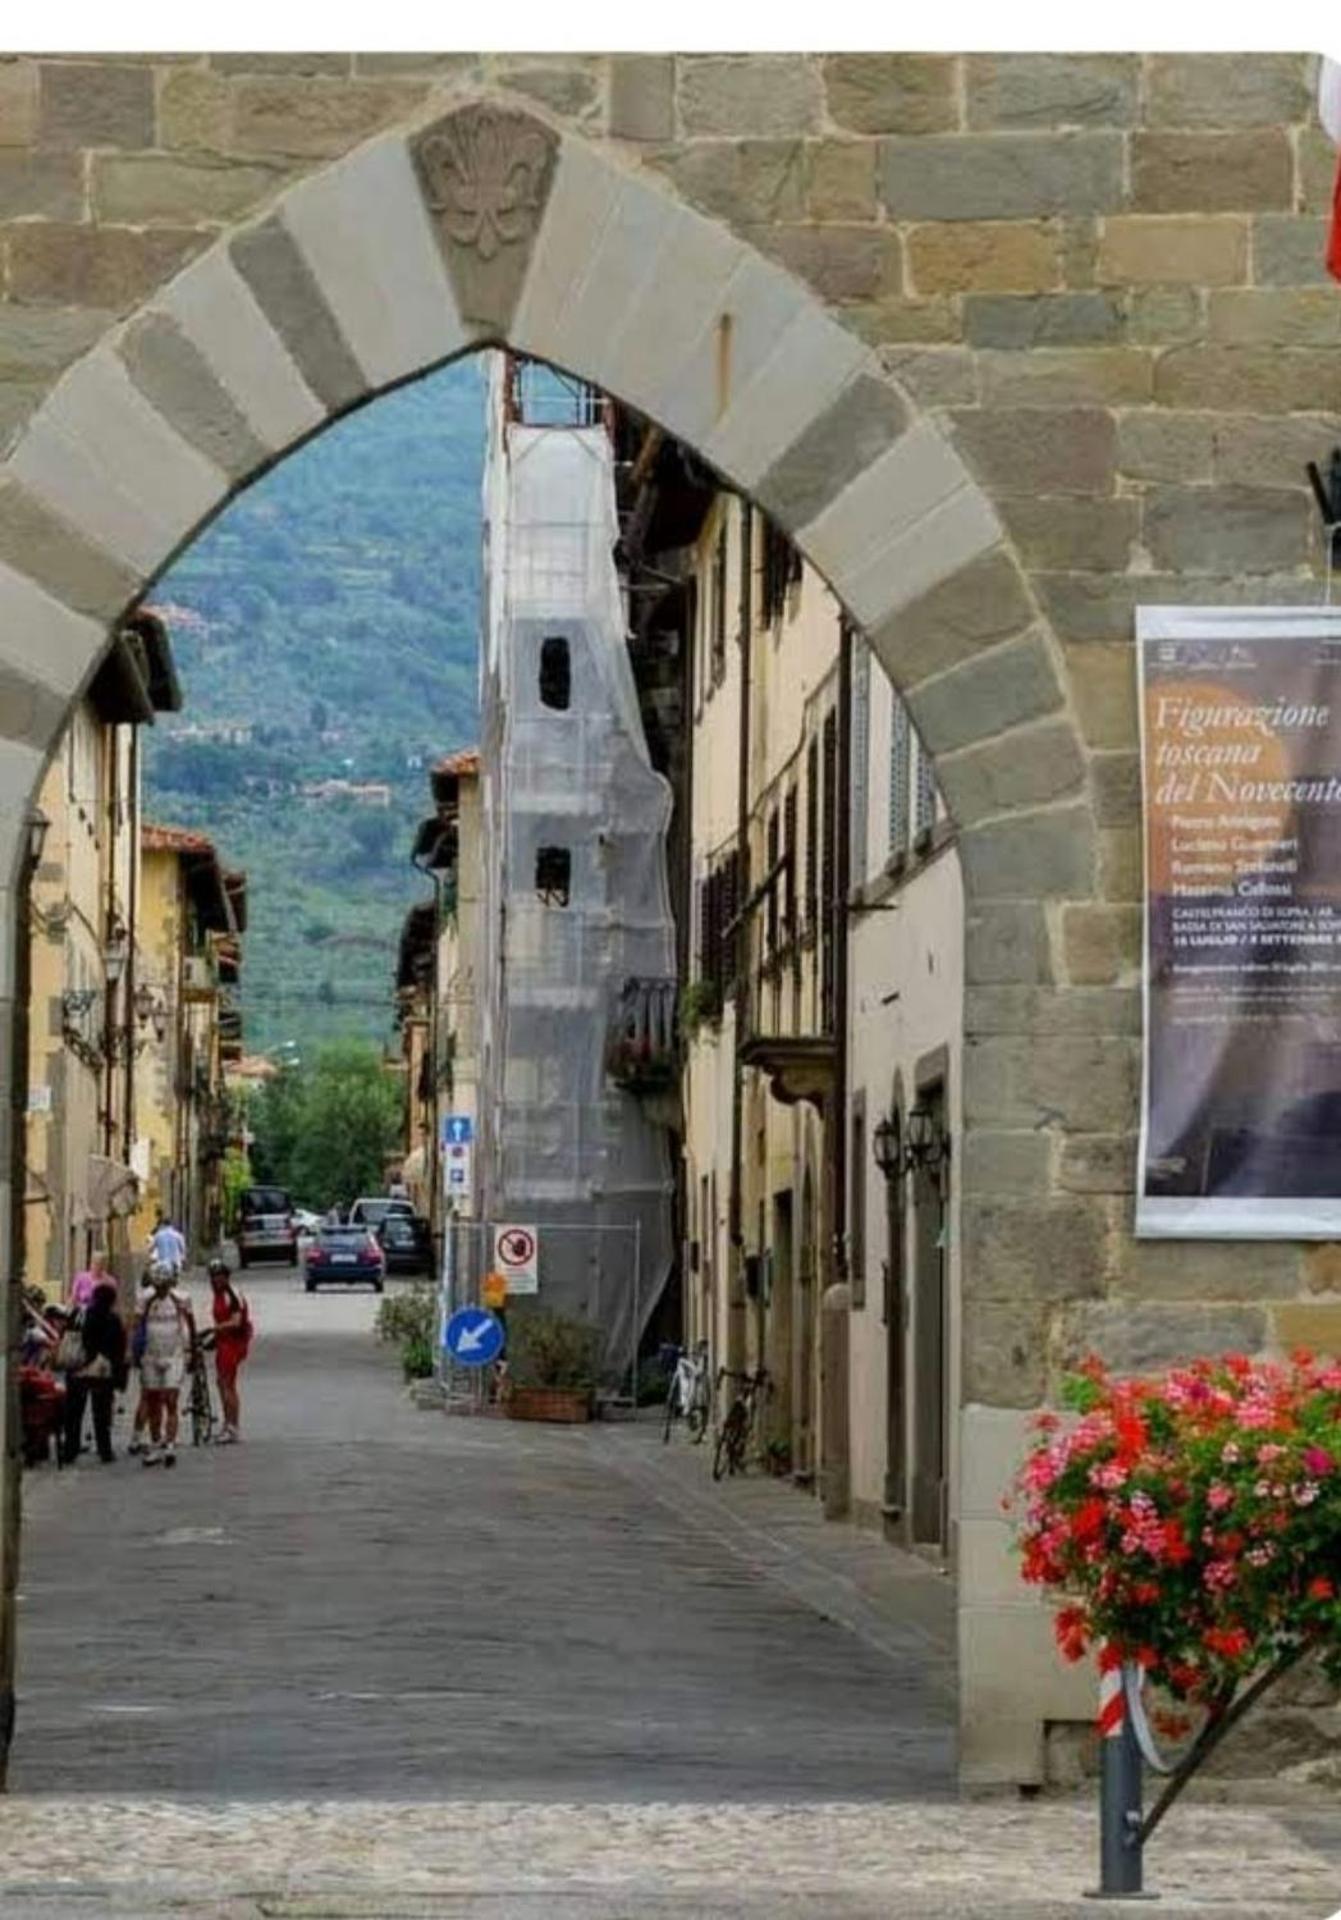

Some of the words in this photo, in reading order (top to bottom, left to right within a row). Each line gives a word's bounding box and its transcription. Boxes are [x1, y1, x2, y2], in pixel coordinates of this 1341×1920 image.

[1156, 696, 1329, 737] Figurazione
[1156, 740, 1262, 766] toscana
[1156, 772, 1200, 804] del
